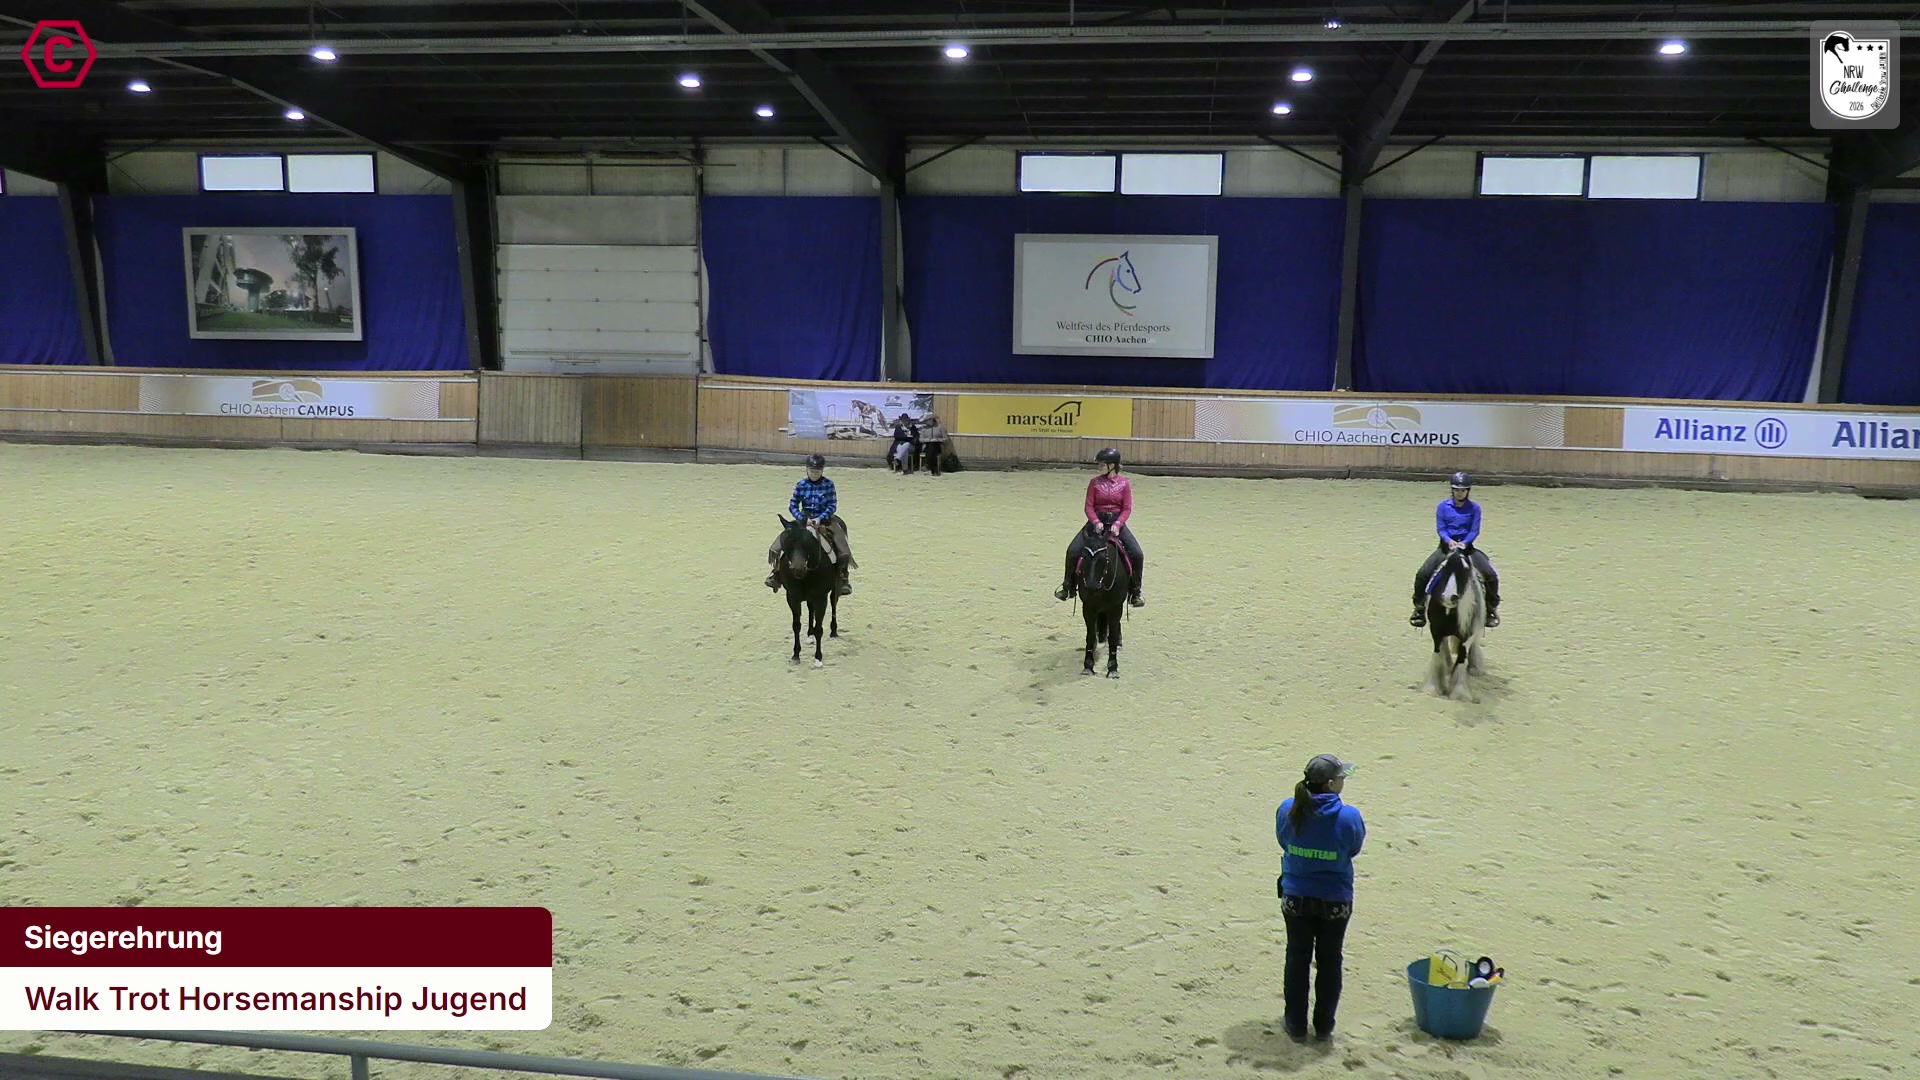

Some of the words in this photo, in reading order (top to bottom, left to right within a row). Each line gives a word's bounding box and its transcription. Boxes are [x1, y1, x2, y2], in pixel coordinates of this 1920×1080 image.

[1056, 321, 1093, 331] Weltfest
[1095, 321, 1111, 331] des
[1114, 322, 1170, 333] Pferdesports
[1085, 335, 1112, 344] CHIO
[1114, 336, 1147, 344] Aachen
[220, 403, 252, 415] CHIO
[254, 404, 295, 416] Aachen
[298, 405, 354, 417] CAMPUS
[1007, 412, 1073, 426] marstall
[1654, 418, 1746, 442] Allianz
[1294, 430, 1333, 442] CHIO
[1336, 431, 1387, 444] Aachen
[1390, 432, 1460, 445] CAMPUS
[1287, 844, 1337, 860] SHOWTEAM
